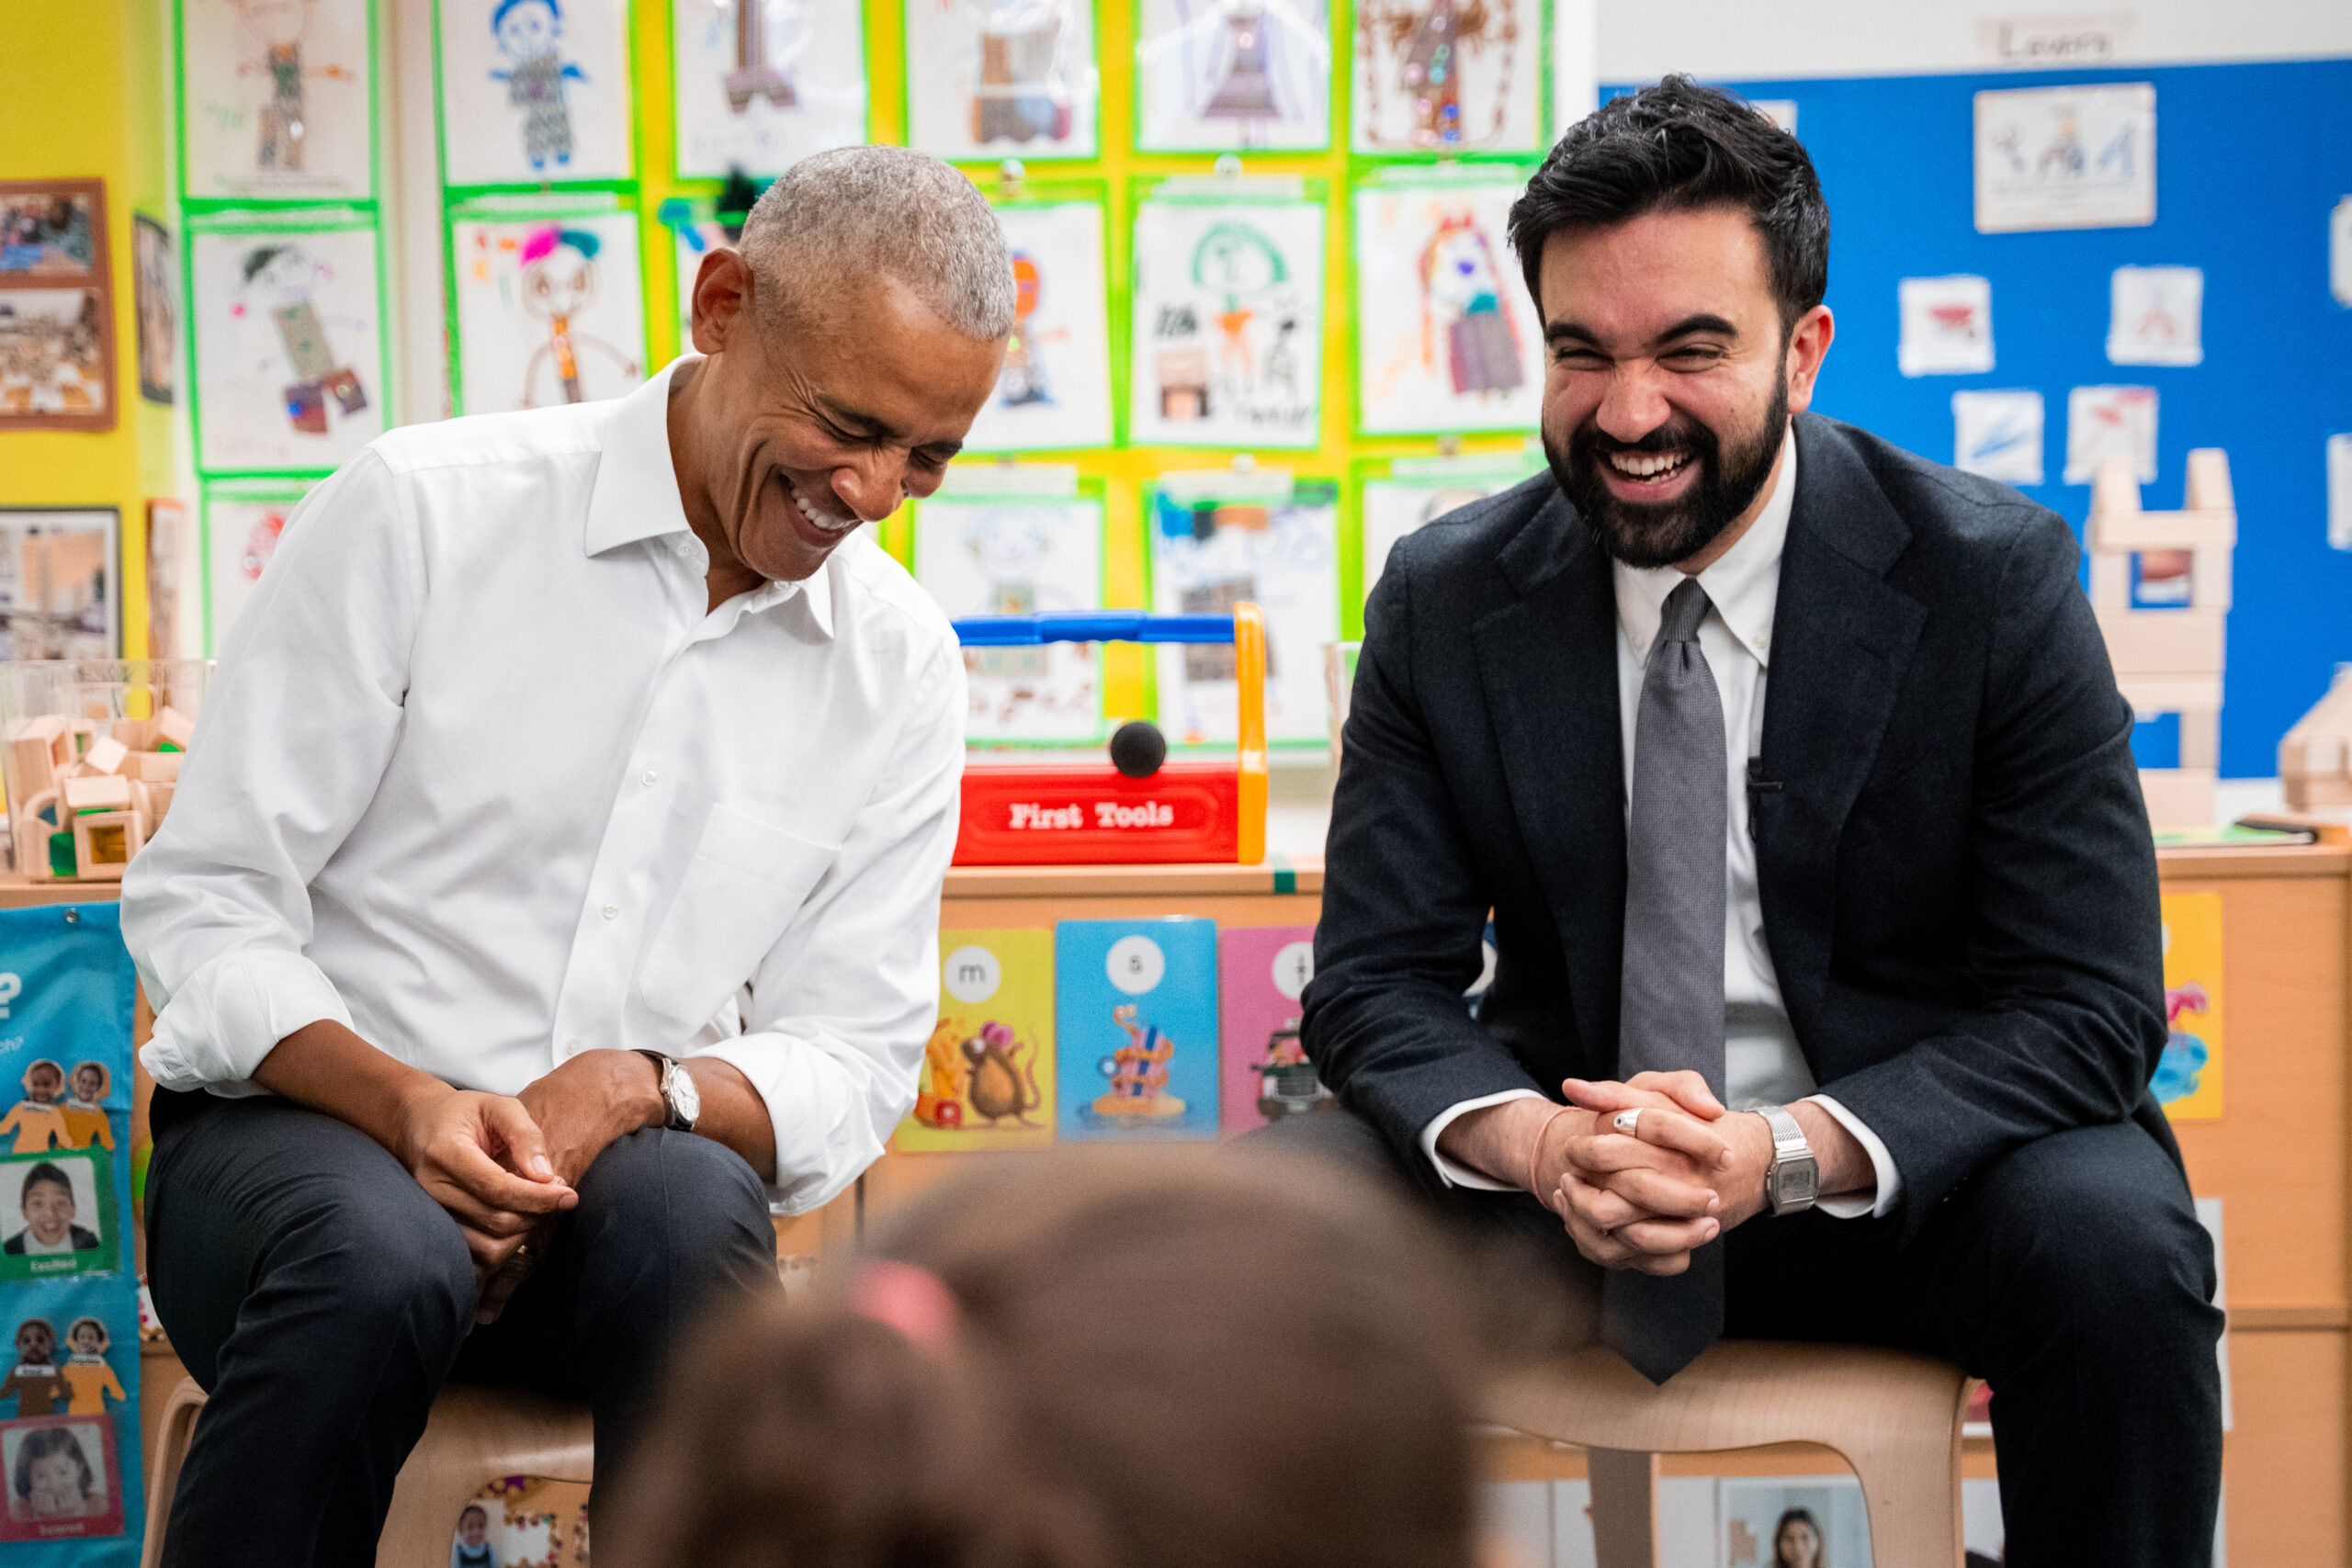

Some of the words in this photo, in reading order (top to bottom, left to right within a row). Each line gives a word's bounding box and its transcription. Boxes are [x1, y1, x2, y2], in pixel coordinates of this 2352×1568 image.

[1009, 803, 1084, 829] First
[1094, 800, 1174, 828] Tools
[958, 964, 986, 983] m
[1128, 954, 1145, 975] s
